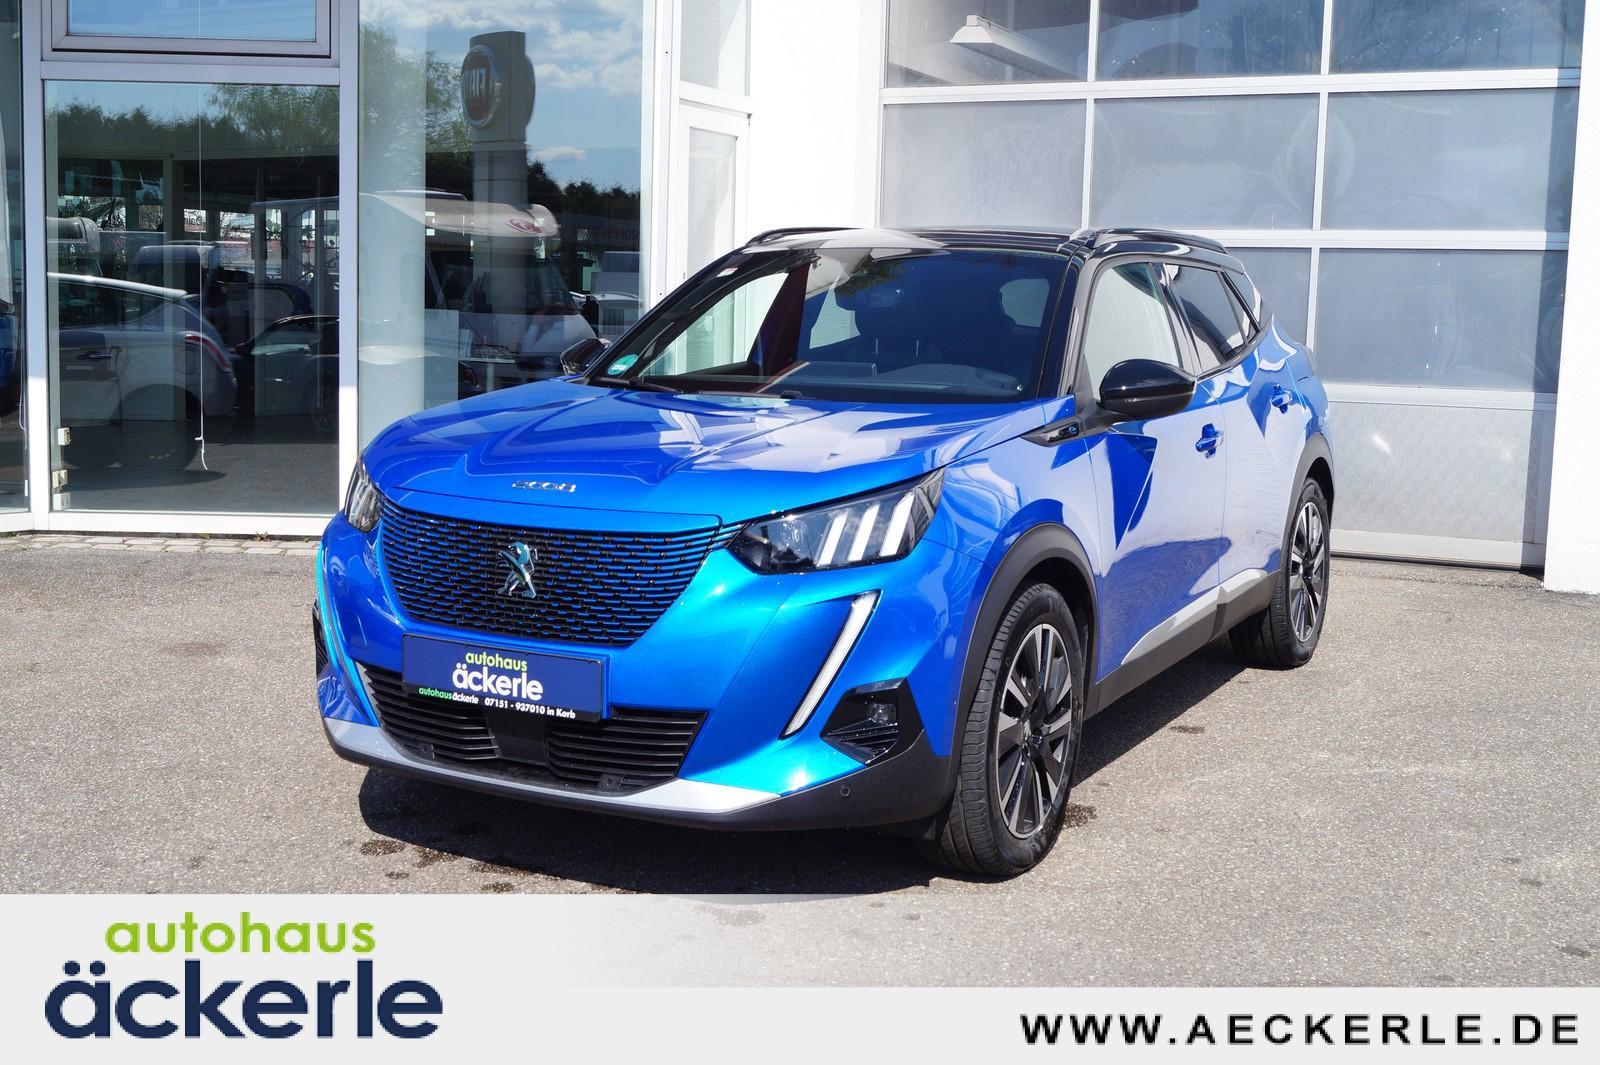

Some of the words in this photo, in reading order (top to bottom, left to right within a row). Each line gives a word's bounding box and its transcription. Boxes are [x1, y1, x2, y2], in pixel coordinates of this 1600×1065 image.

[465, 651, 528, 671] autohaus
[452, 662, 544, 700] äckerle
[484, 696, 510, 709] 07151
[516, 700, 546, 715] 937010
[547, 705, 556, 716] in
[556, 707, 576, 719] Korb
